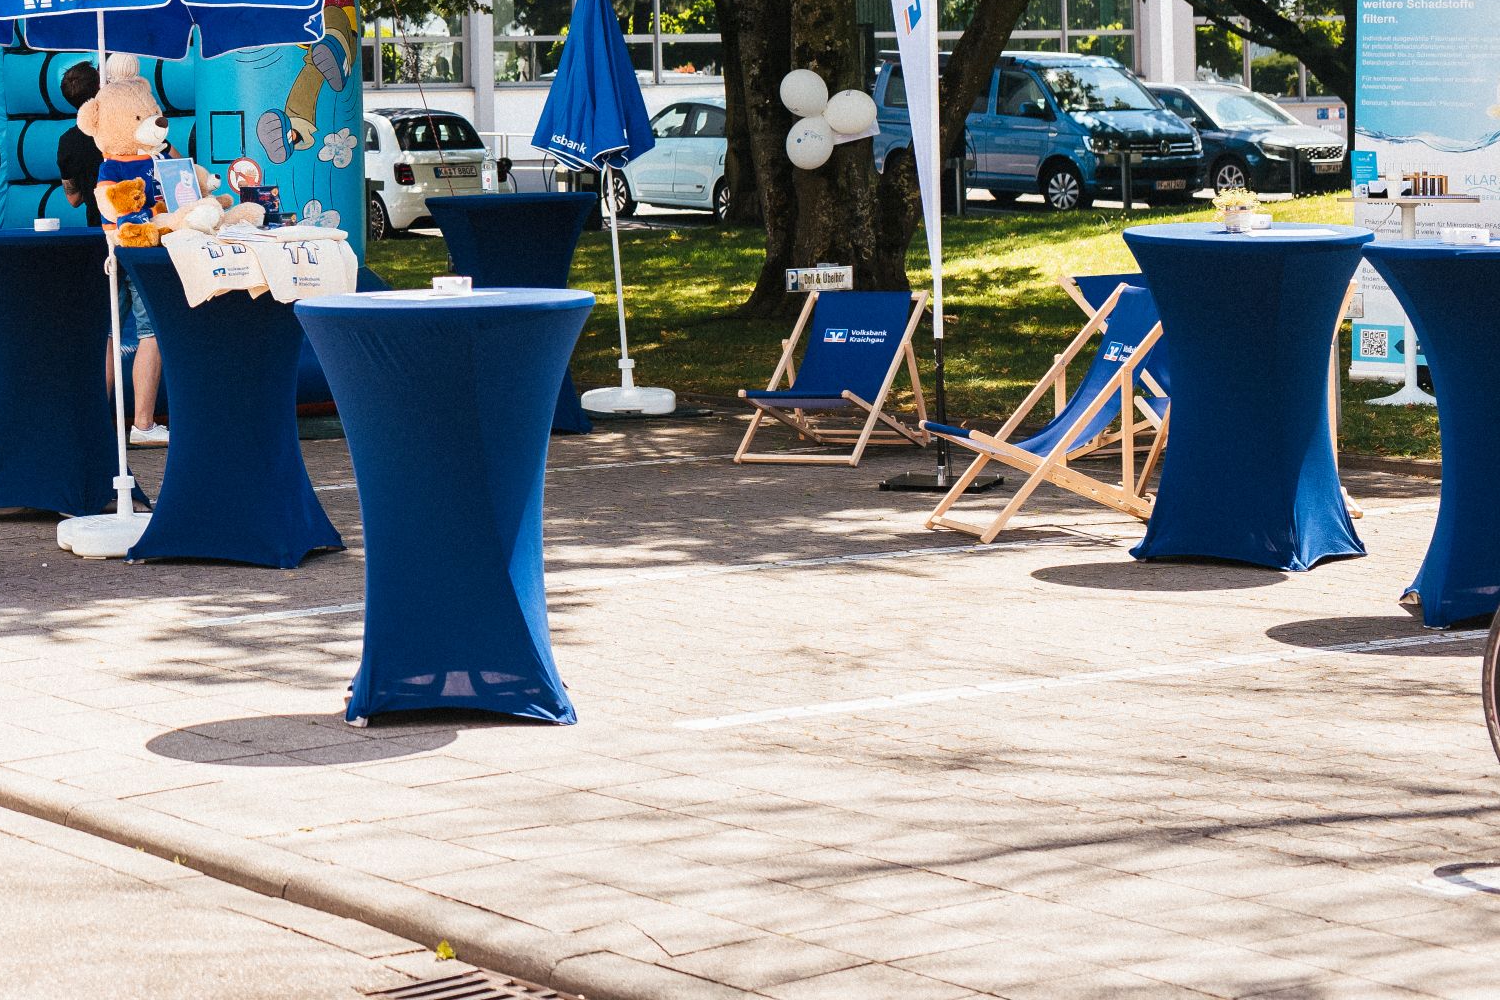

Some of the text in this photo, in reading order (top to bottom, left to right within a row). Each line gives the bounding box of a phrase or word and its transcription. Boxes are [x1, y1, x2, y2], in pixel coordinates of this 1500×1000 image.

[1363, 0, 1475, 9] weitere Schadstoffe
[1363, 14, 1399, 24] filtern.
[551, 132, 587, 154] ksbank
[788, 271, 797, 290] P
[816, 273, 821, 284] &
[851, 329, 888, 337] Volksbank
[849, 337, 885, 345] Kraichgau
